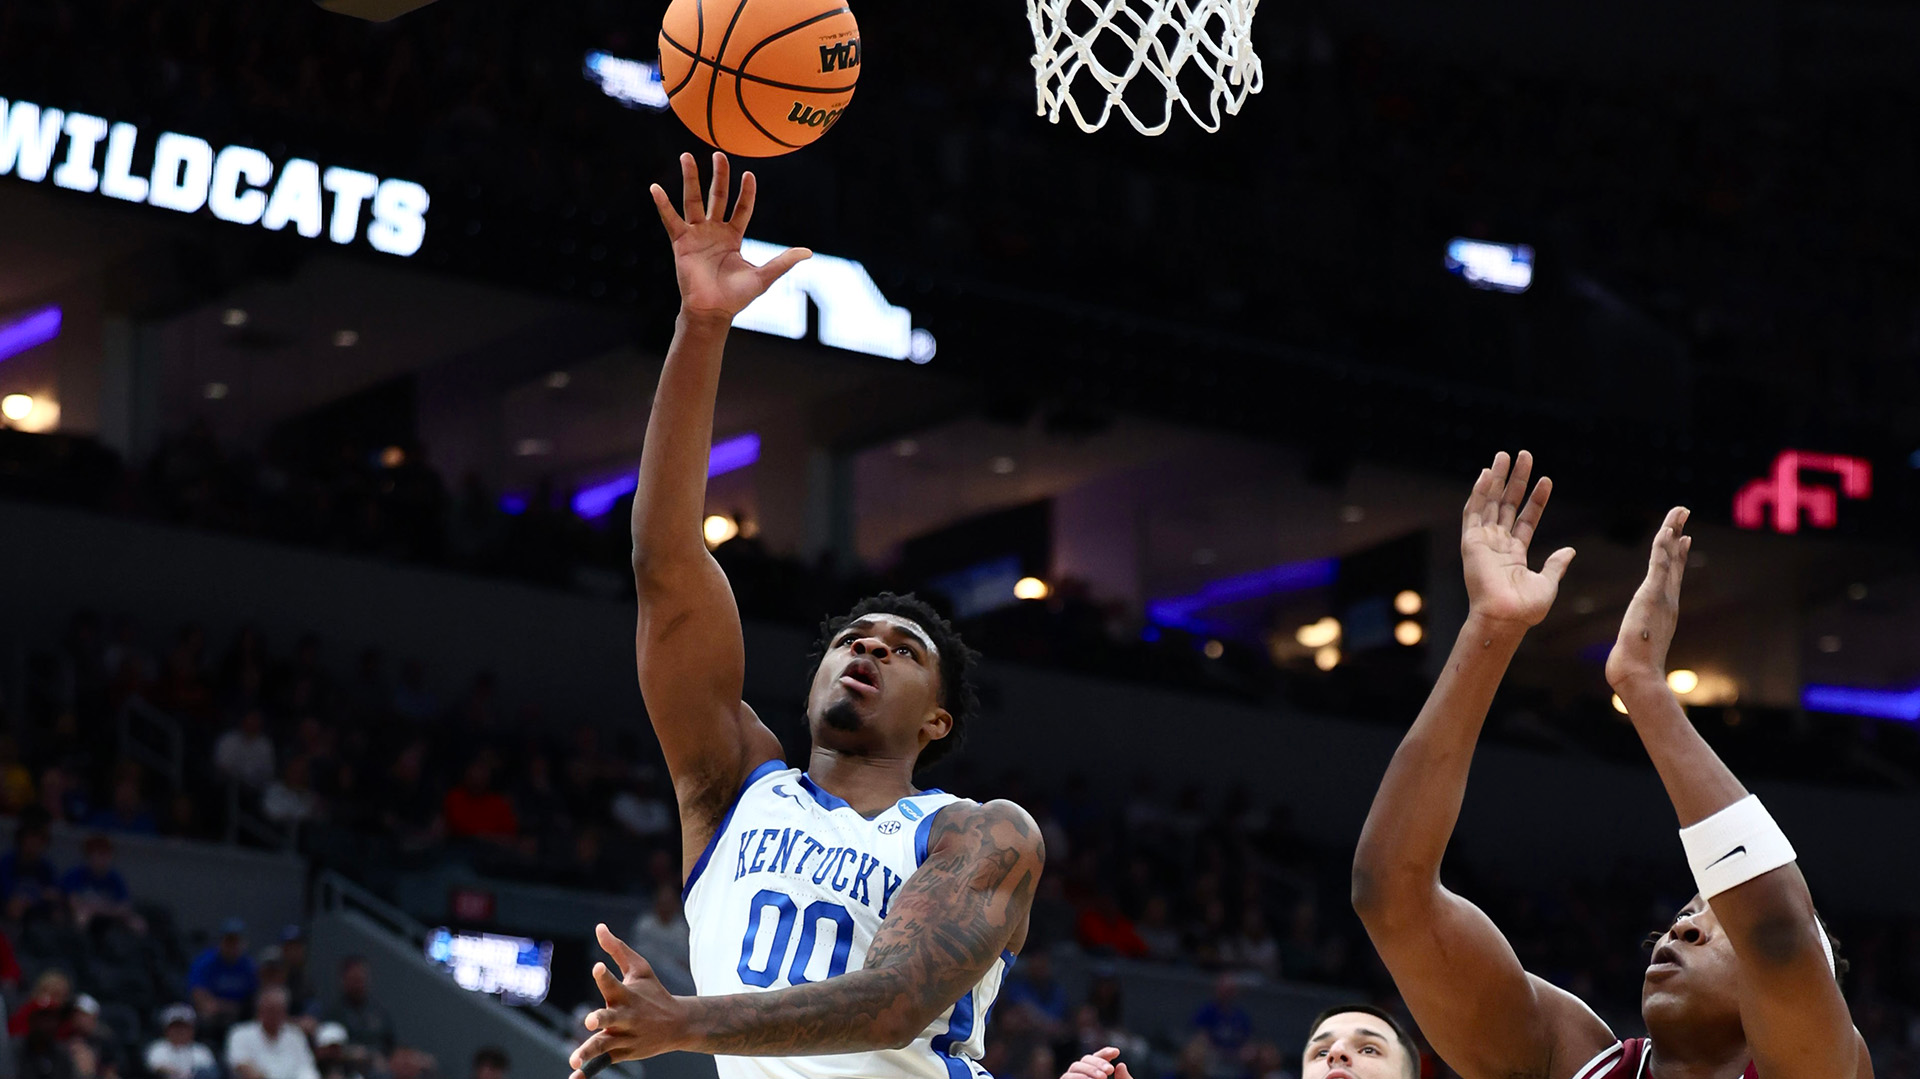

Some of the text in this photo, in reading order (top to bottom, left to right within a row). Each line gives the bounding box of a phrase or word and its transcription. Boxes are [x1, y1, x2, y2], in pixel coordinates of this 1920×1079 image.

[819, 38, 861, 73] CAA
[0, 97, 430, 257] WILDCATS
[734, 827, 902, 920] KENTUCKY
[878, 821, 901, 835] SEC
[737, 888, 854, 989] 00
